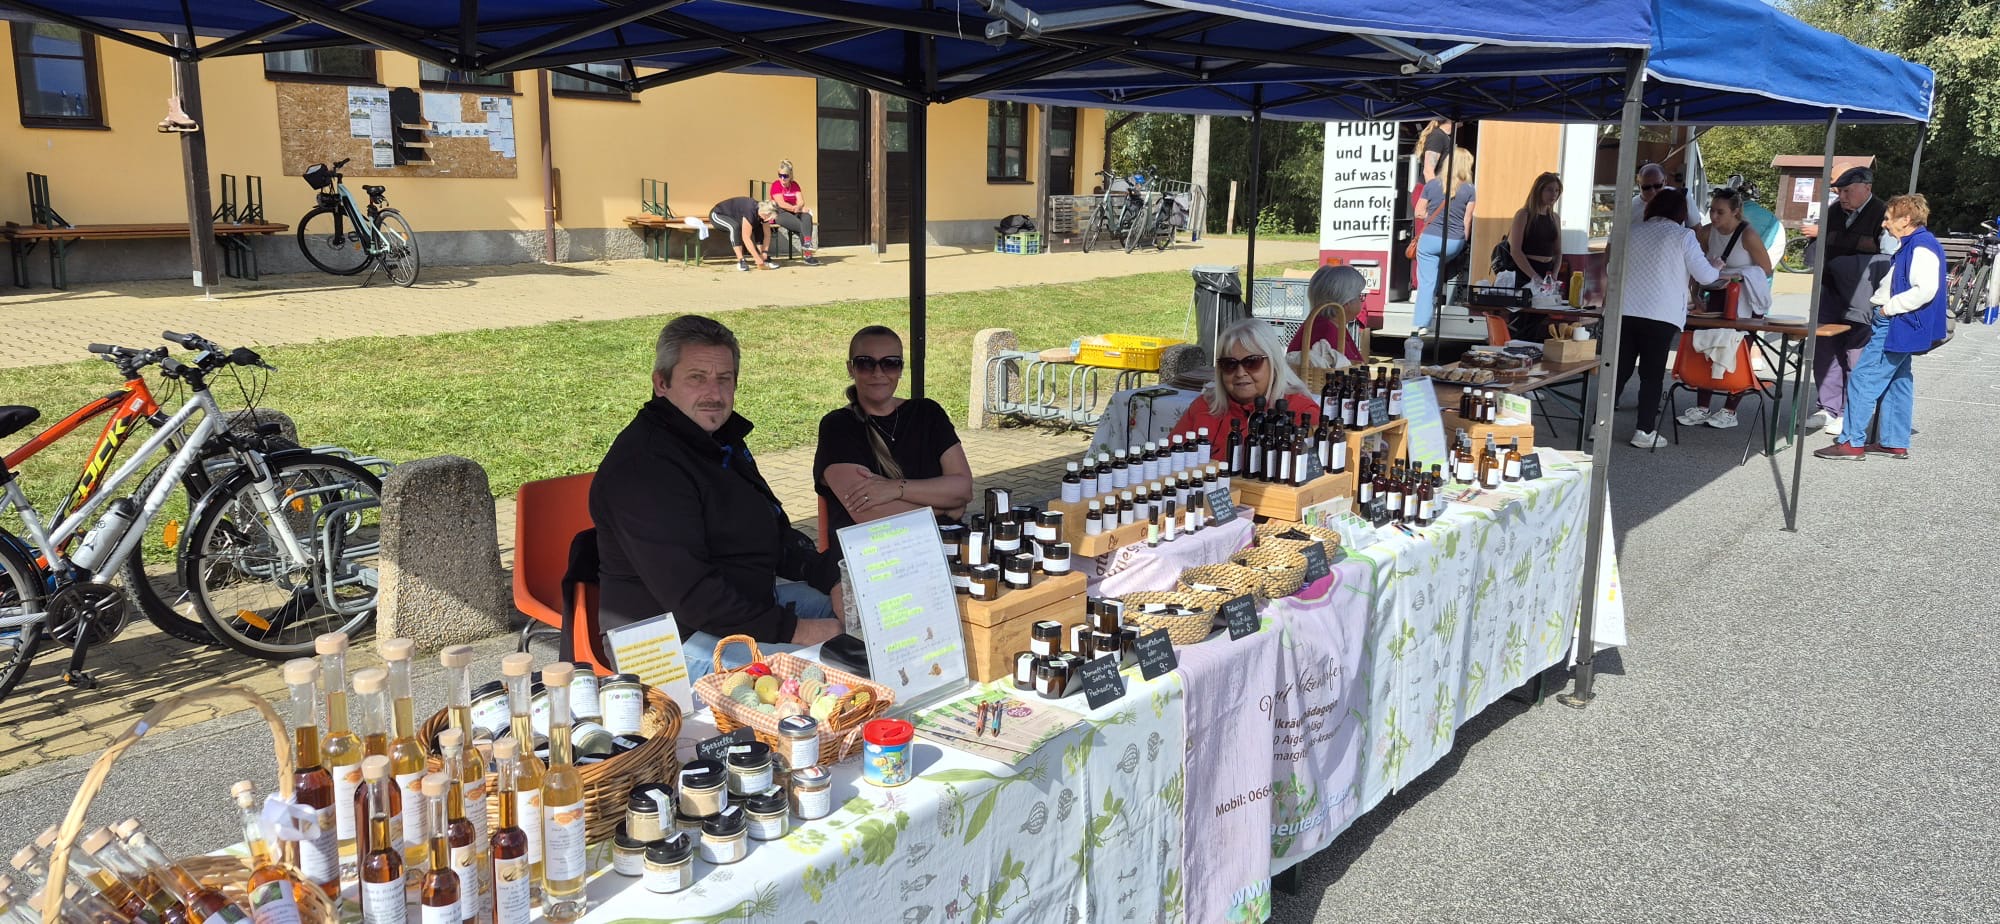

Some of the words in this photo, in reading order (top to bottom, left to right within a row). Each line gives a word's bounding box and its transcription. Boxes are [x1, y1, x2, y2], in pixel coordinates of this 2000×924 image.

[1336, 145, 1362, 159] und
[1371, 144, 1394, 162] Lu
[1335, 168, 1357, 181] auf
[1360, 171, 1386, 181] was
[1334, 196, 1364, 208] dann
[1215, 795, 1246, 818] Mobil:
